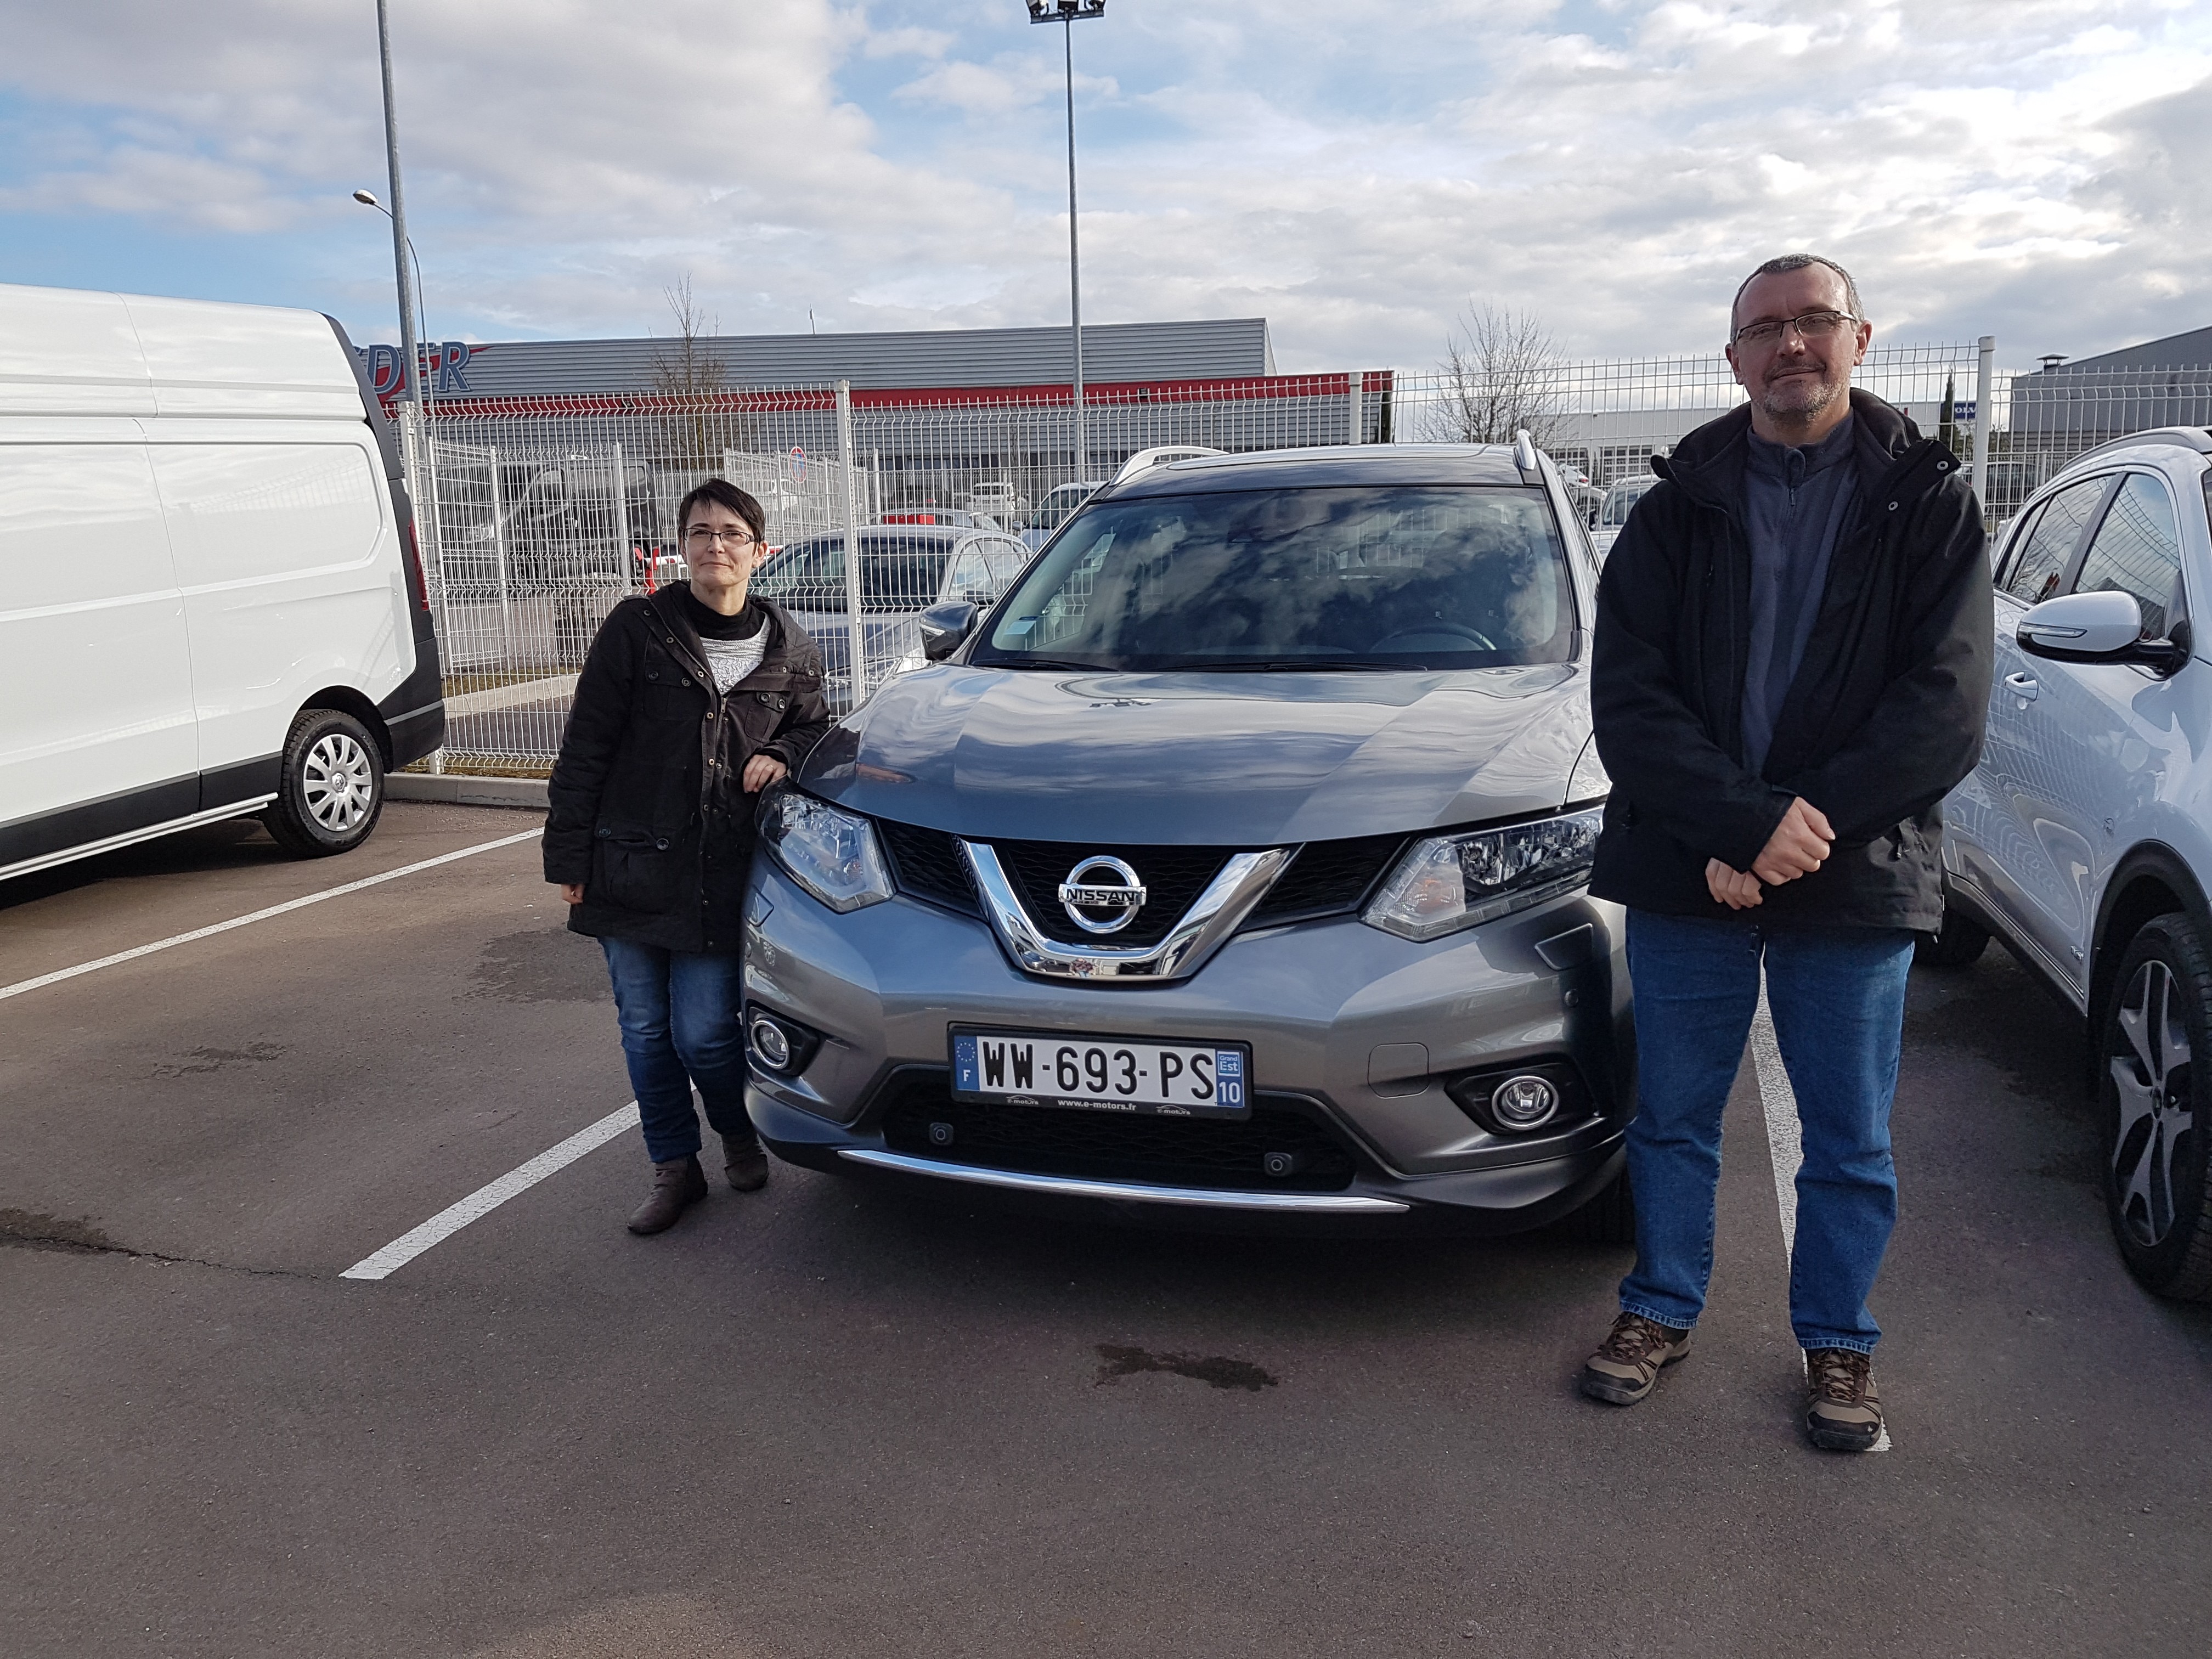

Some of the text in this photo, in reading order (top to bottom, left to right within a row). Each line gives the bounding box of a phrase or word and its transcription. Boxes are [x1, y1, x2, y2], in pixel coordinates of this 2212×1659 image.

[353, 341, 471, 394] DR
[1066, 888, 1134, 901] NISSAN
[1220, 1061, 1238, 1071] Est
[963, 1069, 970, 1081] F
[1219, 1081, 1240, 1103] 10
[1058, 1099, 1137, 1110] www.e-motors.fr
